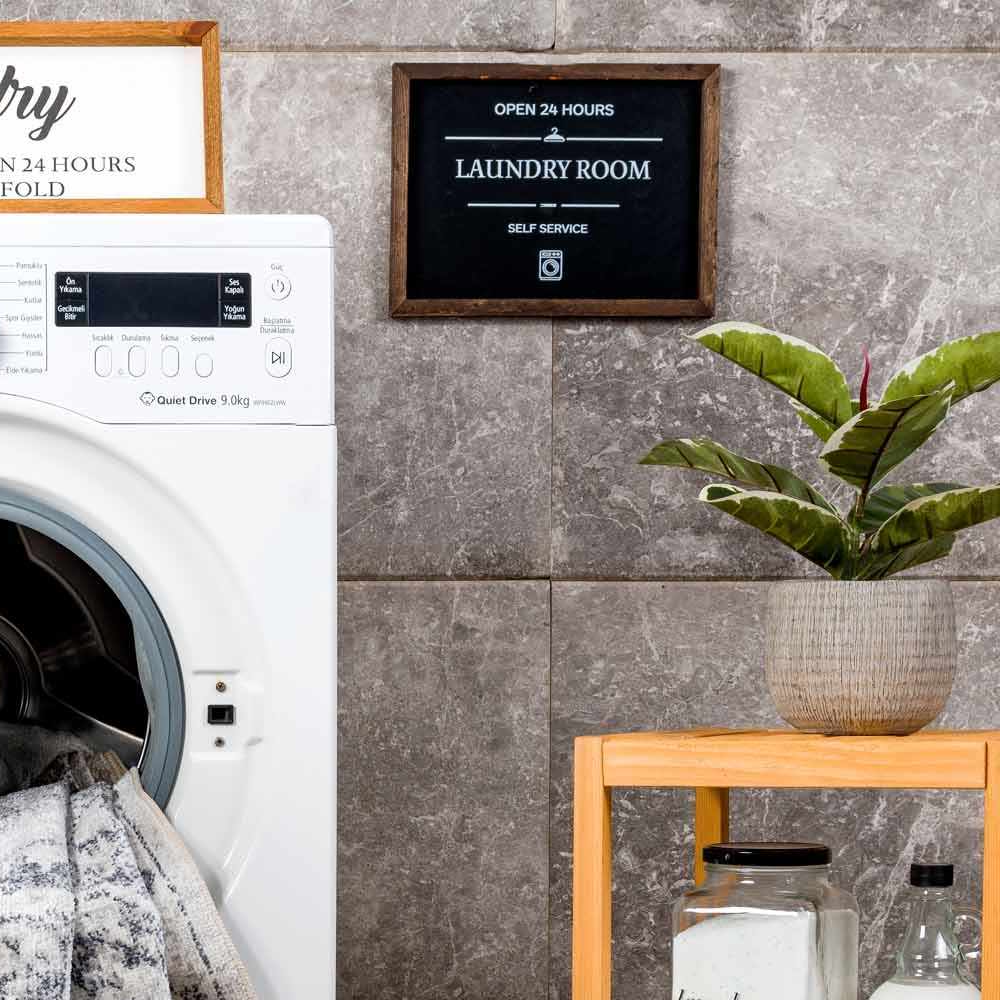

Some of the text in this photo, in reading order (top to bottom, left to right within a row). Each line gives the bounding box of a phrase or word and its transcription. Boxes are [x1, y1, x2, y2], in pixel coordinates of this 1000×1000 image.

[494, 103, 615, 117] OPEN 24 HOURS
[22, 157, 46, 173] 24
[52, 157, 136, 173] HOURS
[455, 158, 652, 180] LAUNDRY ROOM
[0, 181, 65, 198] FOLD
[507, 223, 589, 234] SELF SERVICE
[65, 276, 76, 286] Ön
[228, 278, 240, 286] Ses
[59, 285, 83, 294] Yıkama
[57, 304, 86, 313] Gecikmeli
[224, 304, 245, 314] Yoğun
[64, 312, 77, 321] Bitir
[223, 312, 246, 321] Yıkama
[156, 395, 186, 406] Quiet
[189, 395, 217, 406] Drive
[220, 394, 250, 409] 9.0kg
